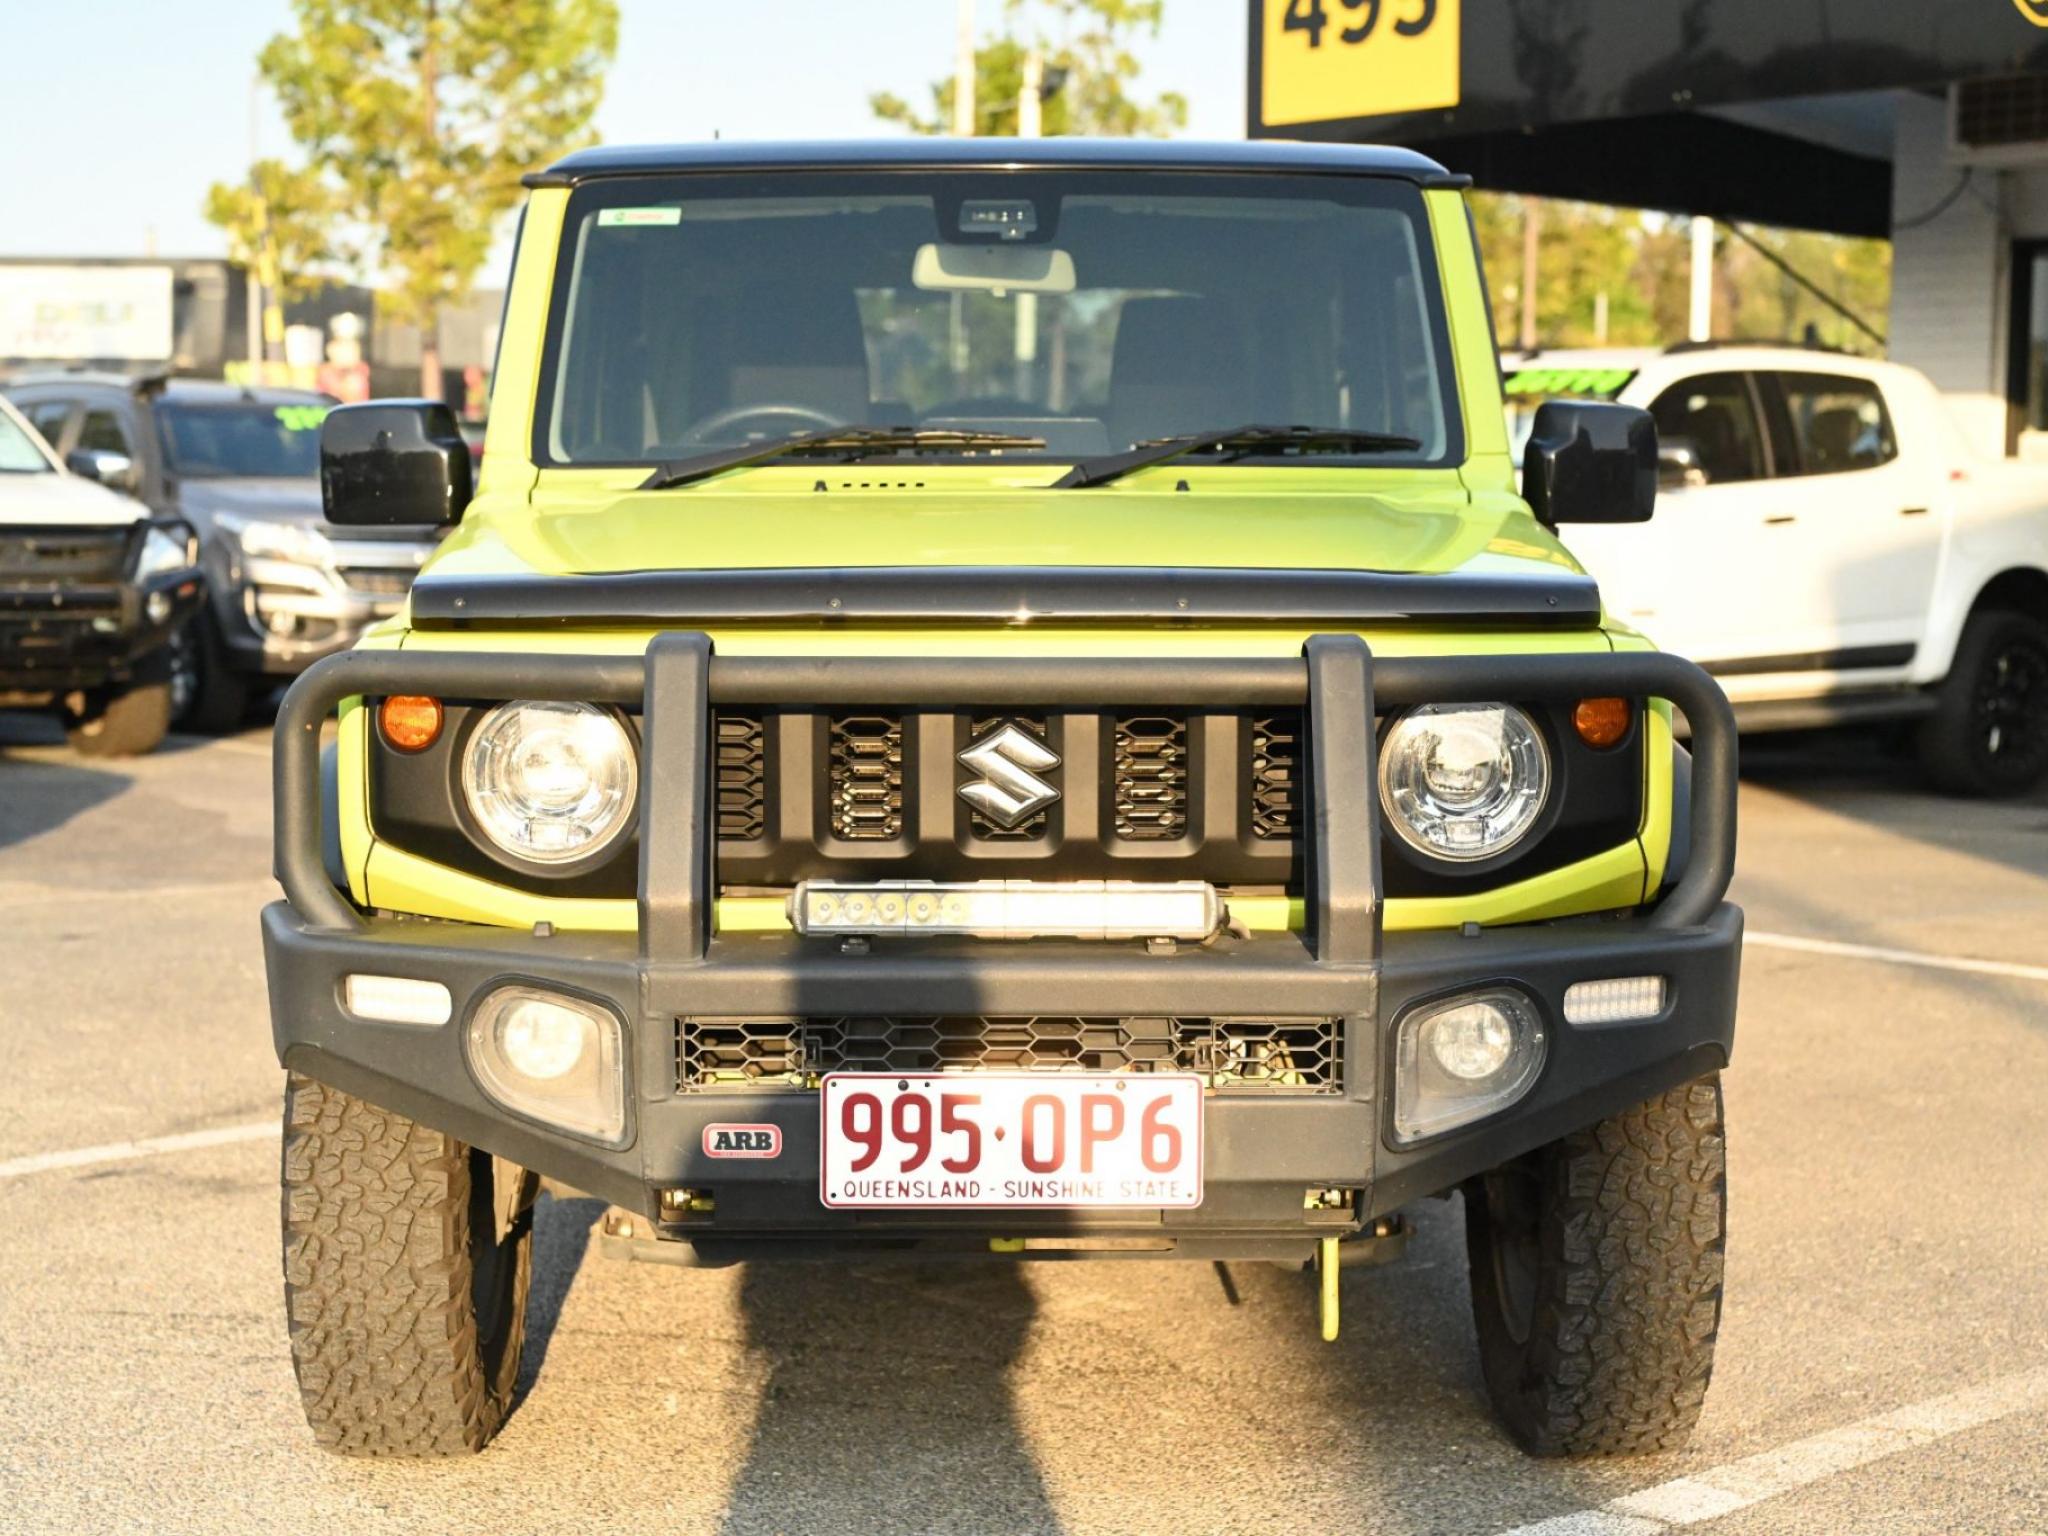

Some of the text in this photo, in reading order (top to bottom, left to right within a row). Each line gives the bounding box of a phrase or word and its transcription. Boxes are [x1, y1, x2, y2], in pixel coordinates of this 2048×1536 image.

[714, 1131, 772, 1150] ARB
[844, 1180, 980, 1198] QUEENSLAND
[1004, 1180, 1103, 1198] SUNSHINE
[1120, 1180, 1179, 1198] STATE
